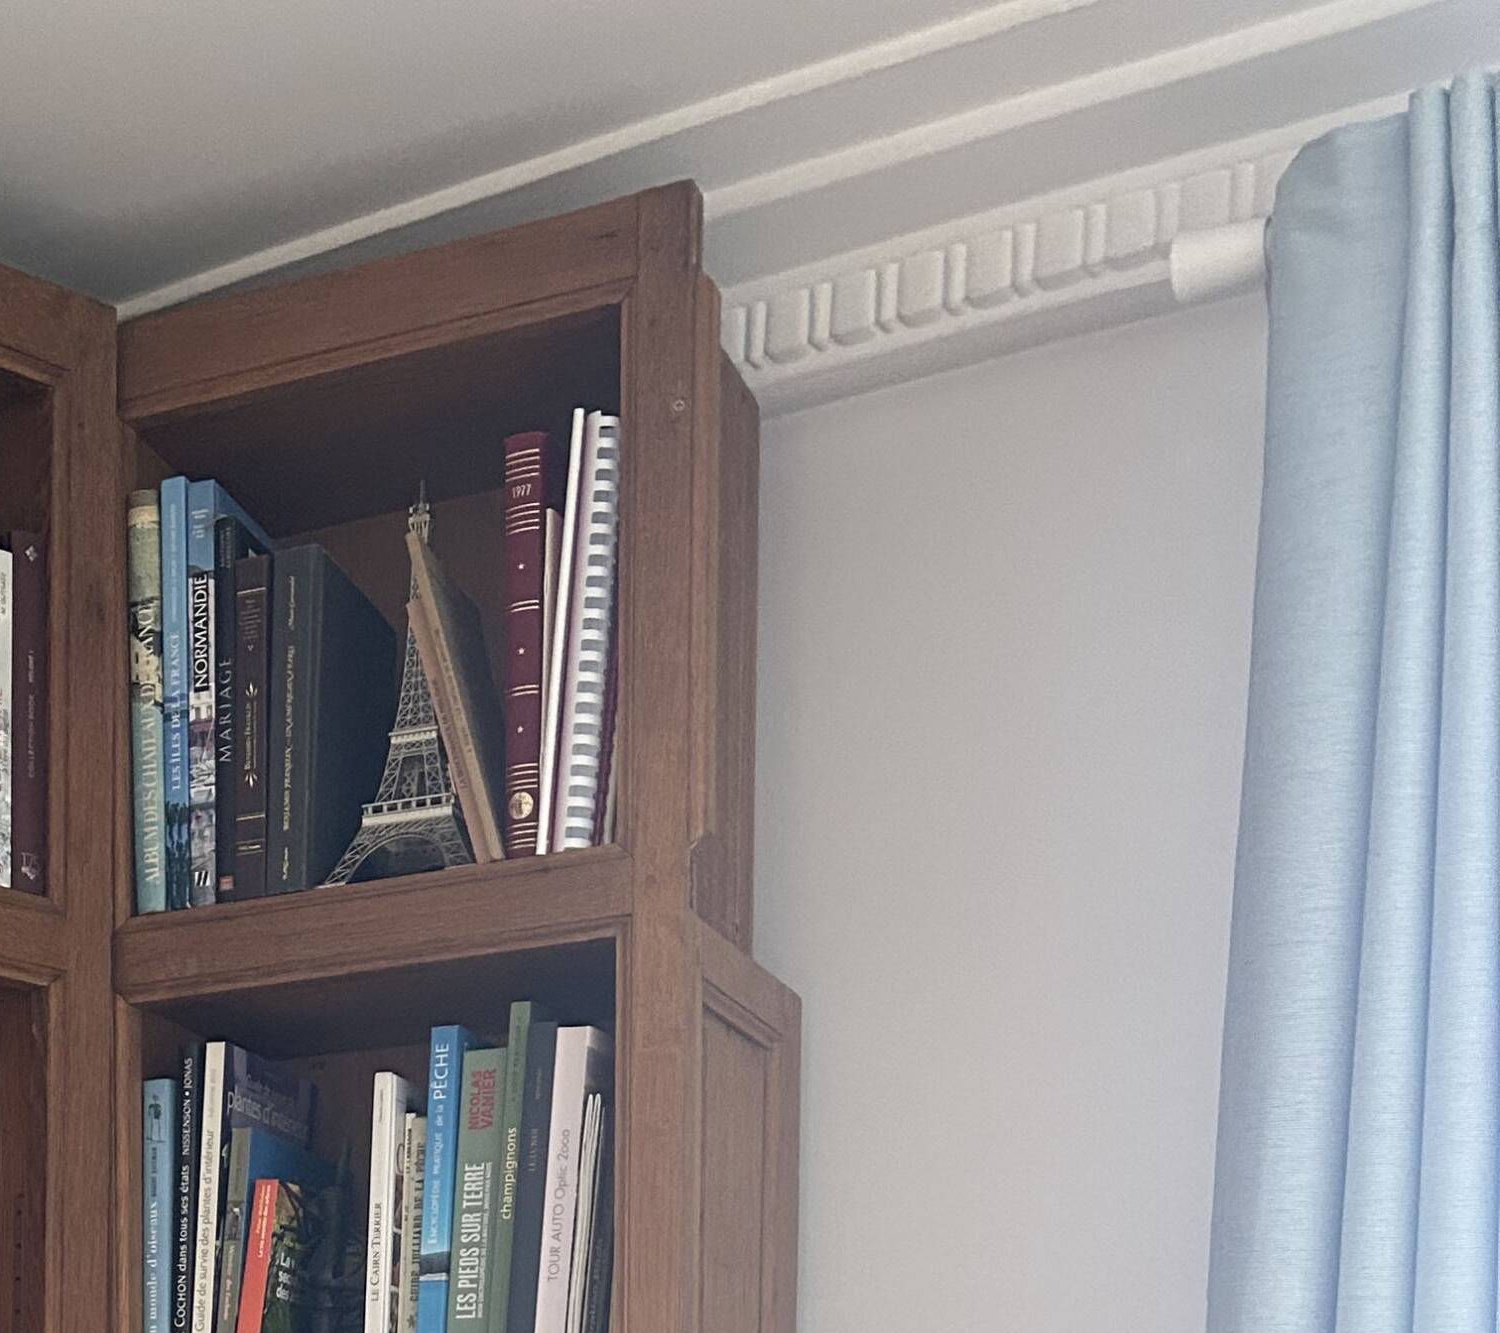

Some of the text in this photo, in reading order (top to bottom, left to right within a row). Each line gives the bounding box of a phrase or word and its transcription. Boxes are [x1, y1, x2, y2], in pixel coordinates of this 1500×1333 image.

[511, 483, 532, 499] 1977
[193, 573, 209, 688] NORMANDIE
[218, 657, 233, 763] MARIAGE
[182, 1057, 193, 1156] NISSENSON JONAS
[467, 1070, 483, 1130] NICOLAS
[478, 1067, 497, 1129] VANIER
[179, 1164, 191, 1194] états
[201, 1128, 215, 1185] d'intérieur
[500, 1126, 518, 1220] champignons
[178, 1217, 189, 1242] tous
[180, 1195, 190, 1215] ses
[199, 1187, 213, 1225] plantes
[546, 1128, 571, 1282] TOUR AUTO Optic 2000
[145, 1200, 158, 1269] d'oiseaux
[176, 1244, 188, 1272] dans
[198, 1227, 210, 1246] des
[369, 1202, 383, 1303] LE CAIRN TERRIER
[455, 1162, 485, 1319] LES PIEDS SUR TERRE
[196, 1282, 207, 1297] de
[197, 1248, 209, 1280] survie
[147, 1271, 158, 1321] monde
[173, 1274, 188, 1328] COCHON
[194, 1299, 207, 1333] Guide
